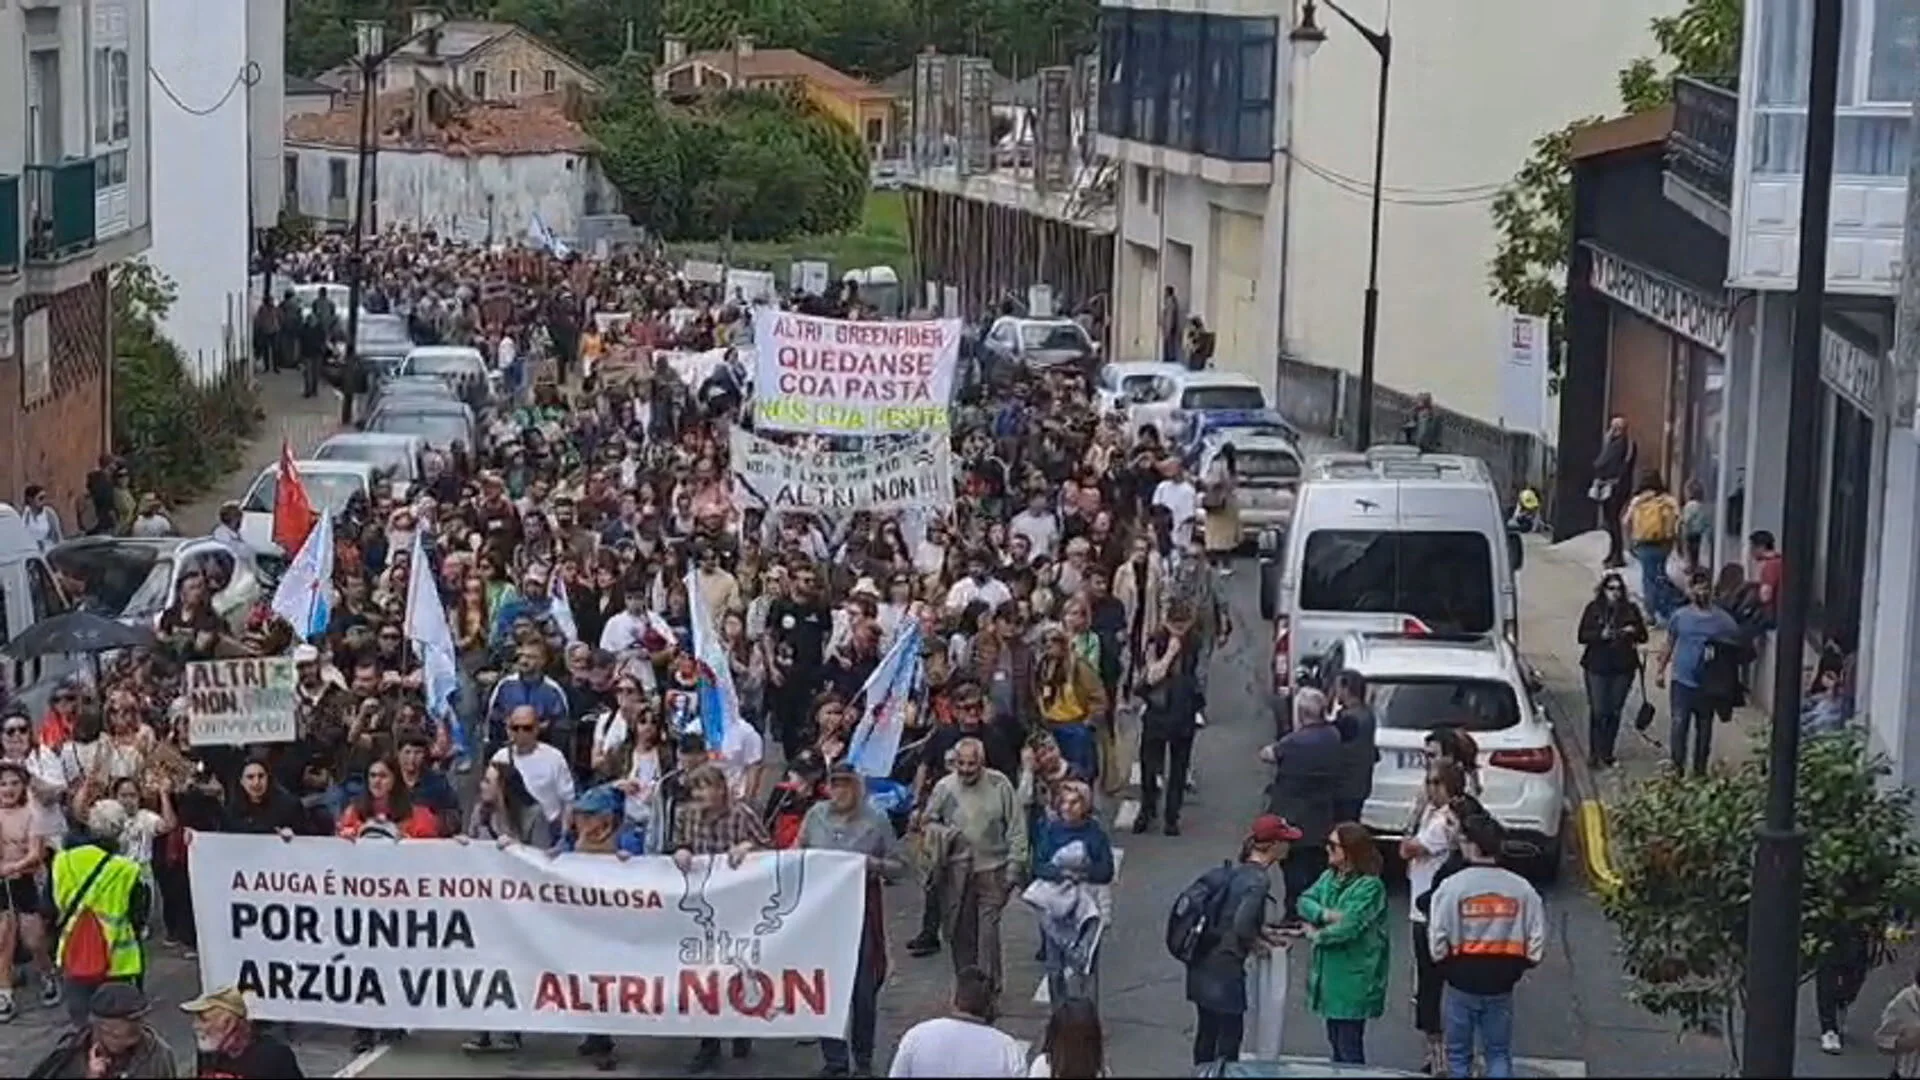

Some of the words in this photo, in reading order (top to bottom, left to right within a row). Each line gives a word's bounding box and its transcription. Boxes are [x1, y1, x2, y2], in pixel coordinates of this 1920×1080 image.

[773, 317, 822, 341] ALTRI
[836, 324, 943, 347] GREENFIBER
[778, 347, 933, 376] QUEDANSE
[779, 373, 836, 398] COA
[846, 378, 930, 401] PASTA
[776, 484, 854, 507] ALTRI
[193, 661, 266, 689] ALTRI
[231, 871, 248, 891] A
[254, 871, 318, 894] AUGA
[324, 869, 337, 896] É
[342, 878, 410, 898] NOSA
[418, 879, 431, 898] E
[439, 878, 493, 899] NON
[501, 880, 533, 901] DA
[538, 884, 663, 908] CELULOSA
[231, 903, 322, 944] POR
[334, 907, 475, 949] UNHA
[678, 930, 761, 965] altri
[238, 952, 386, 1006] ARZÚA
[400, 968, 518, 1009] VIVA
[535, 971, 664, 1015] ALTRI
[678, 968, 826, 1018] NON
